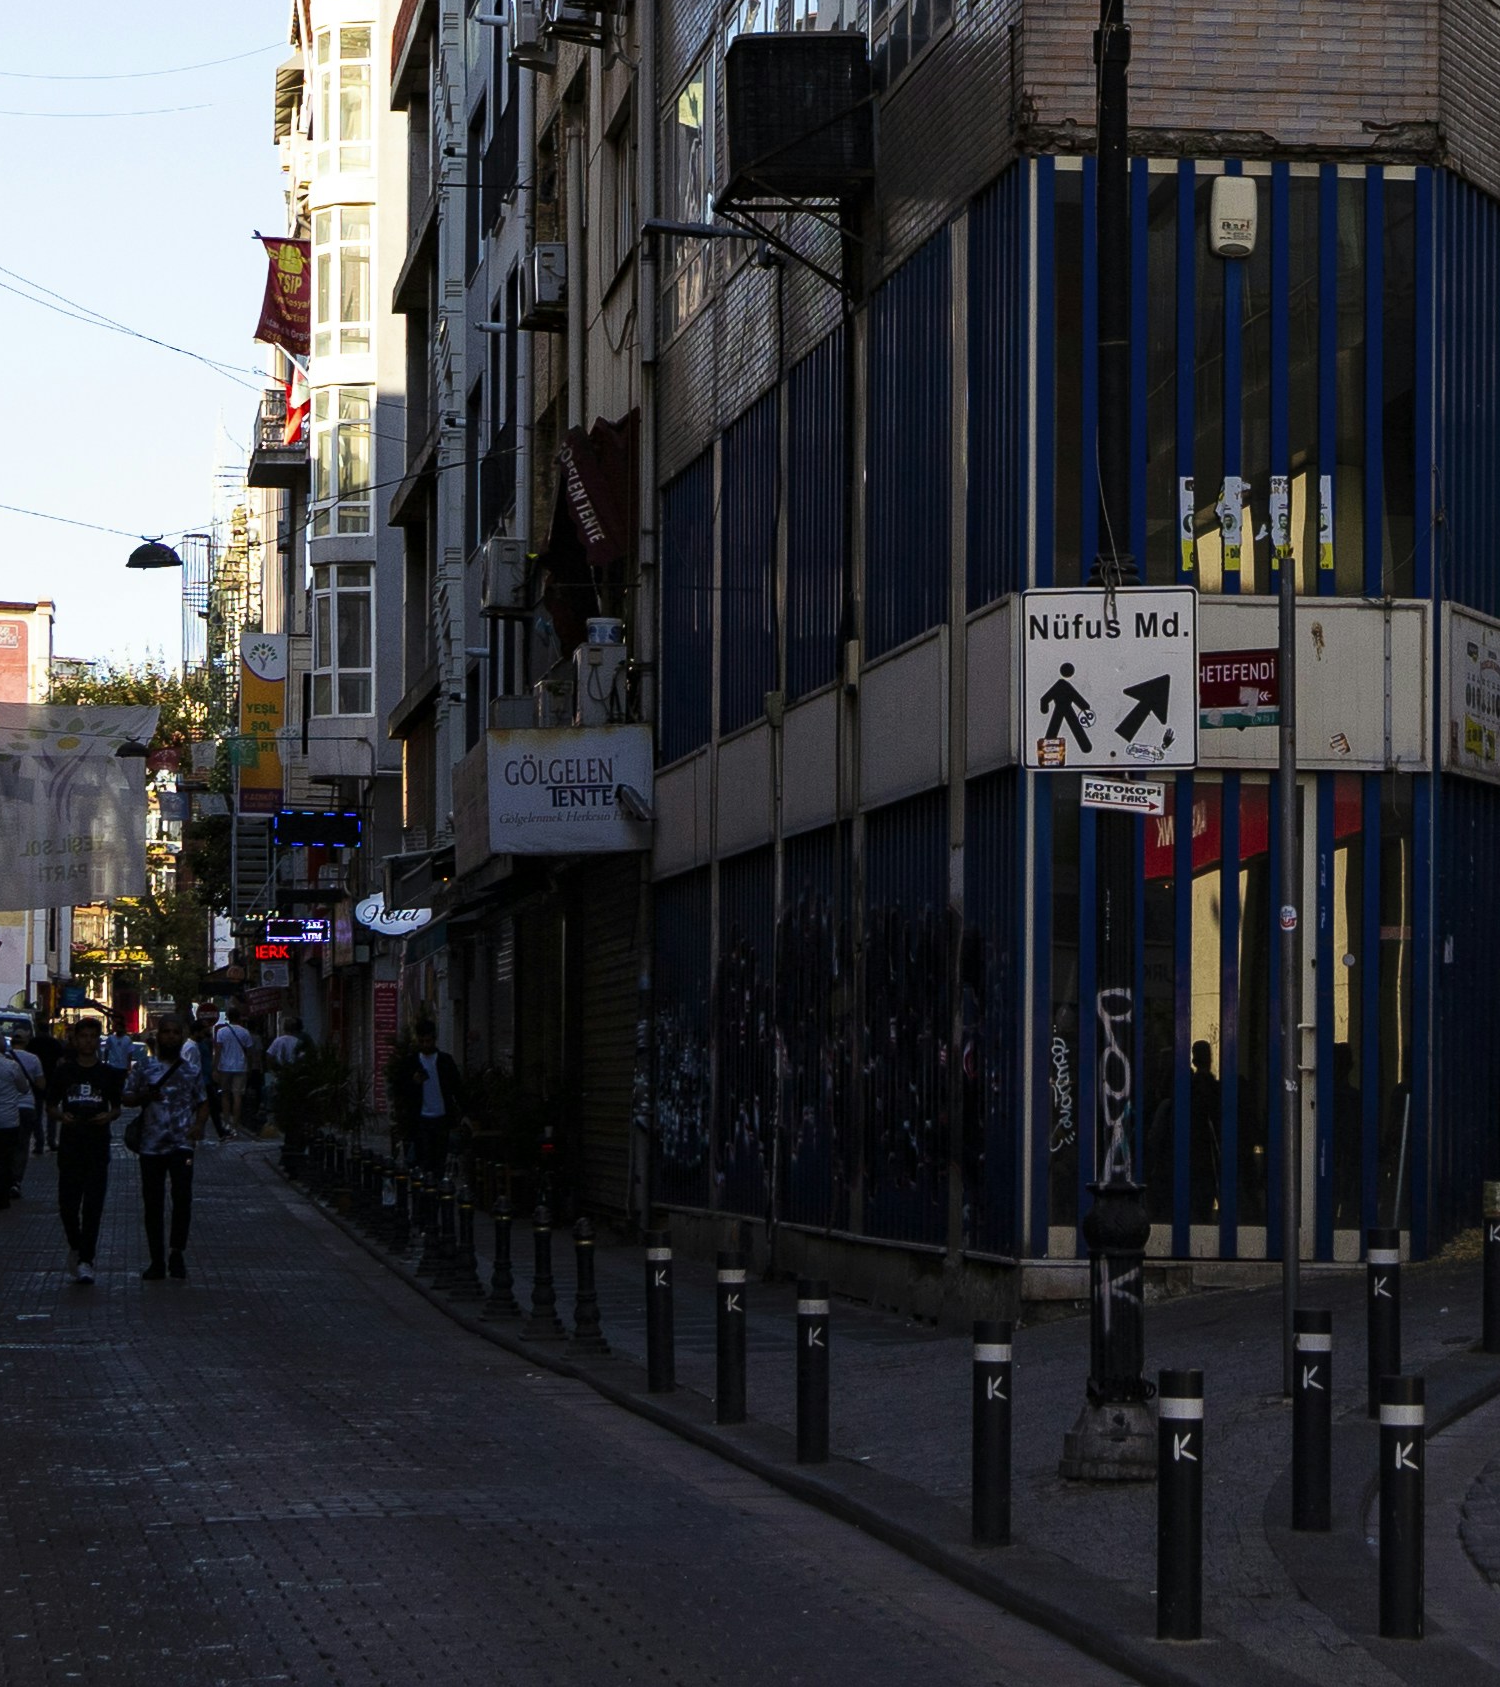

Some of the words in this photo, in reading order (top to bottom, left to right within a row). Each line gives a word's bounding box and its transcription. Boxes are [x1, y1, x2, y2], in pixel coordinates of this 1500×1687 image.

[576, 496, 606, 544] TENTE
[1029, 614, 1121, 640] Nüfus
[1135, 612, 1189, 639] Md.
[251, 723, 273, 732] SOL
[505, 755, 613, 786] GÖLGELEN
[547, 785, 614, 807] TENTE
[1085, 782, 1161, 797] FOTOKOPİ
[1120, 794, 1148, 803] FAKS
[499, 811, 563, 825] Gölgelenmek
[362, 904, 420, 924] Hotel
[656, 1270, 666, 1286] K
[1375, 1277, 1391, 1297] K
[727, 1294, 741, 1311] K
[809, 1328, 823, 1346] K
[988, 1376, 1006, 1399] K
[1303, 1366, 1323, 1389] K
[1174, 1433, 1197, 1460] K
[1396, 1442, 1418, 1469] K
